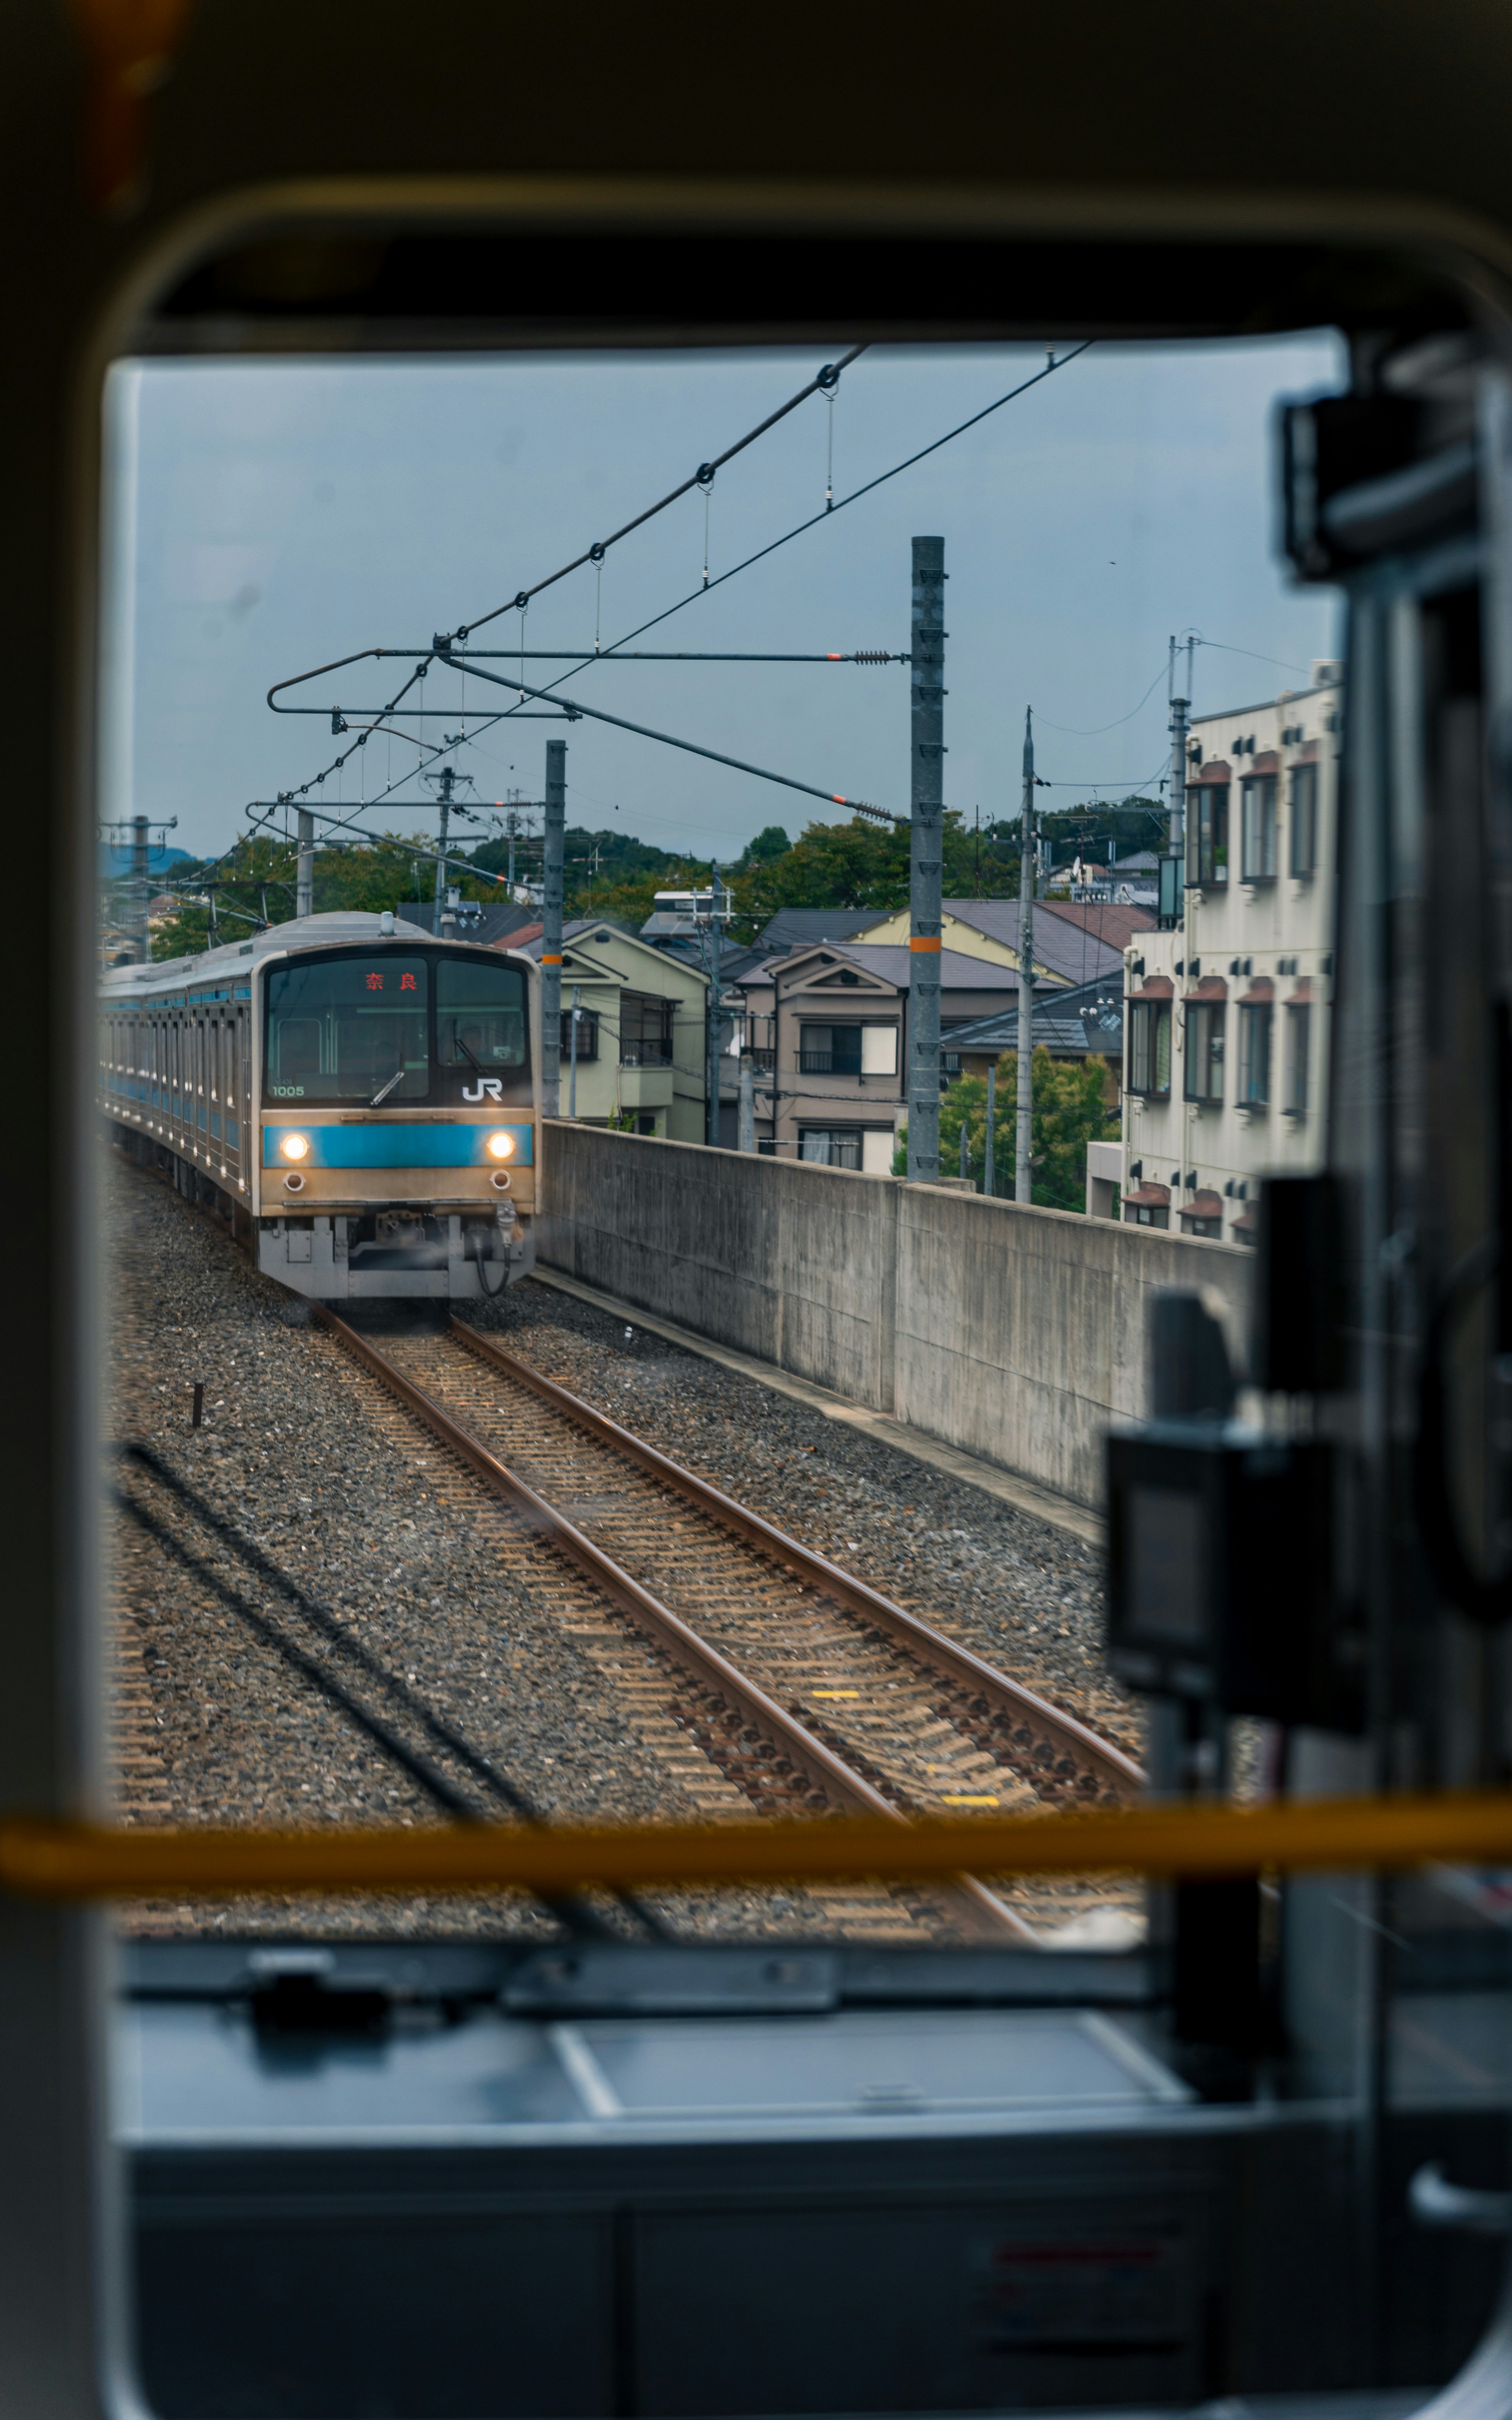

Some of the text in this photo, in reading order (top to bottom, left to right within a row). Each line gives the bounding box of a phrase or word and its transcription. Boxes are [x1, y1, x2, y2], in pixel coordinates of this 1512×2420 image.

[365, 972, 417, 990] 奈良
[272, 1086, 304, 1096] 1005
[462, 1078, 502, 1101] JR
